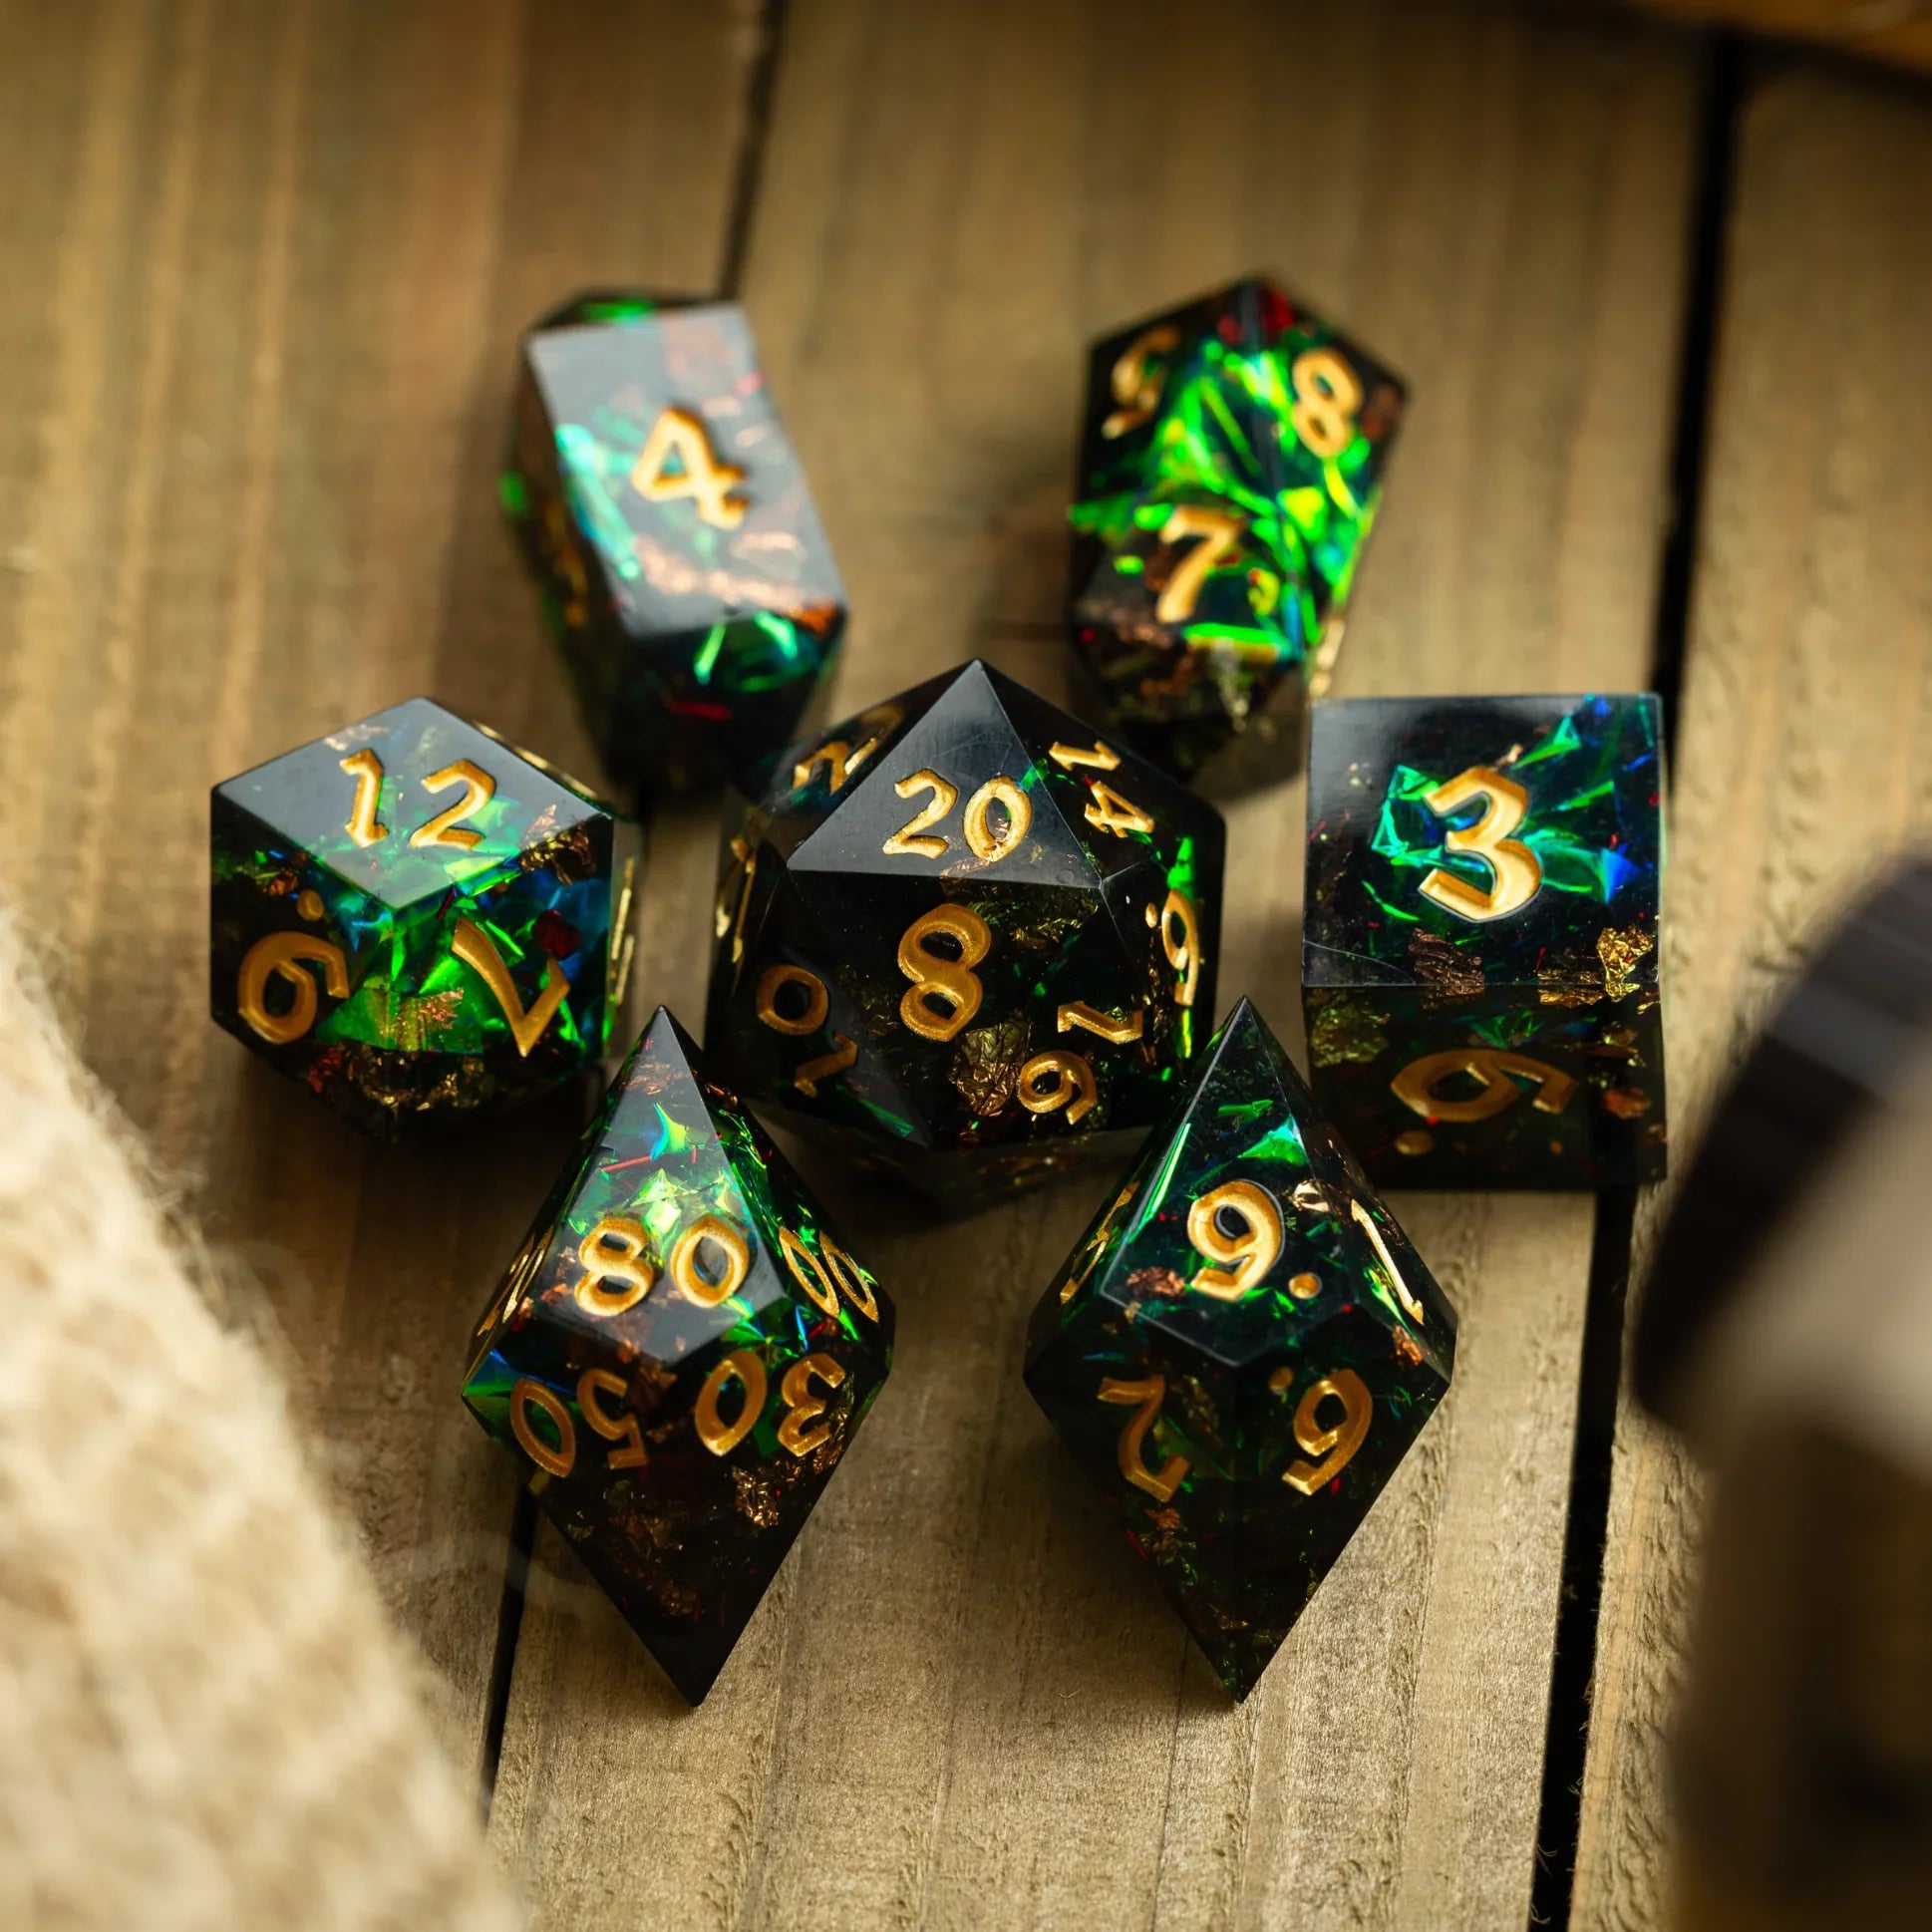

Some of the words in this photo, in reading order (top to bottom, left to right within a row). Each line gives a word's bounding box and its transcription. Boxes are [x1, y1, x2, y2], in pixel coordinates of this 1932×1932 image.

[1292, 348, 1362, 459] 8
[631, 405, 750, 529] 4
[1156, 505, 1247, 623] 7
[339, 748, 496, 850] 12
[882, 768, 1032, 862] 20
[1049, 741, 1155, 838] 14
[1419, 765, 1543, 922] 3
[897, 902, 992, 1042] 8
[575, 1213, 750, 1317] 80
[779, 1226, 879, 1323] 00
